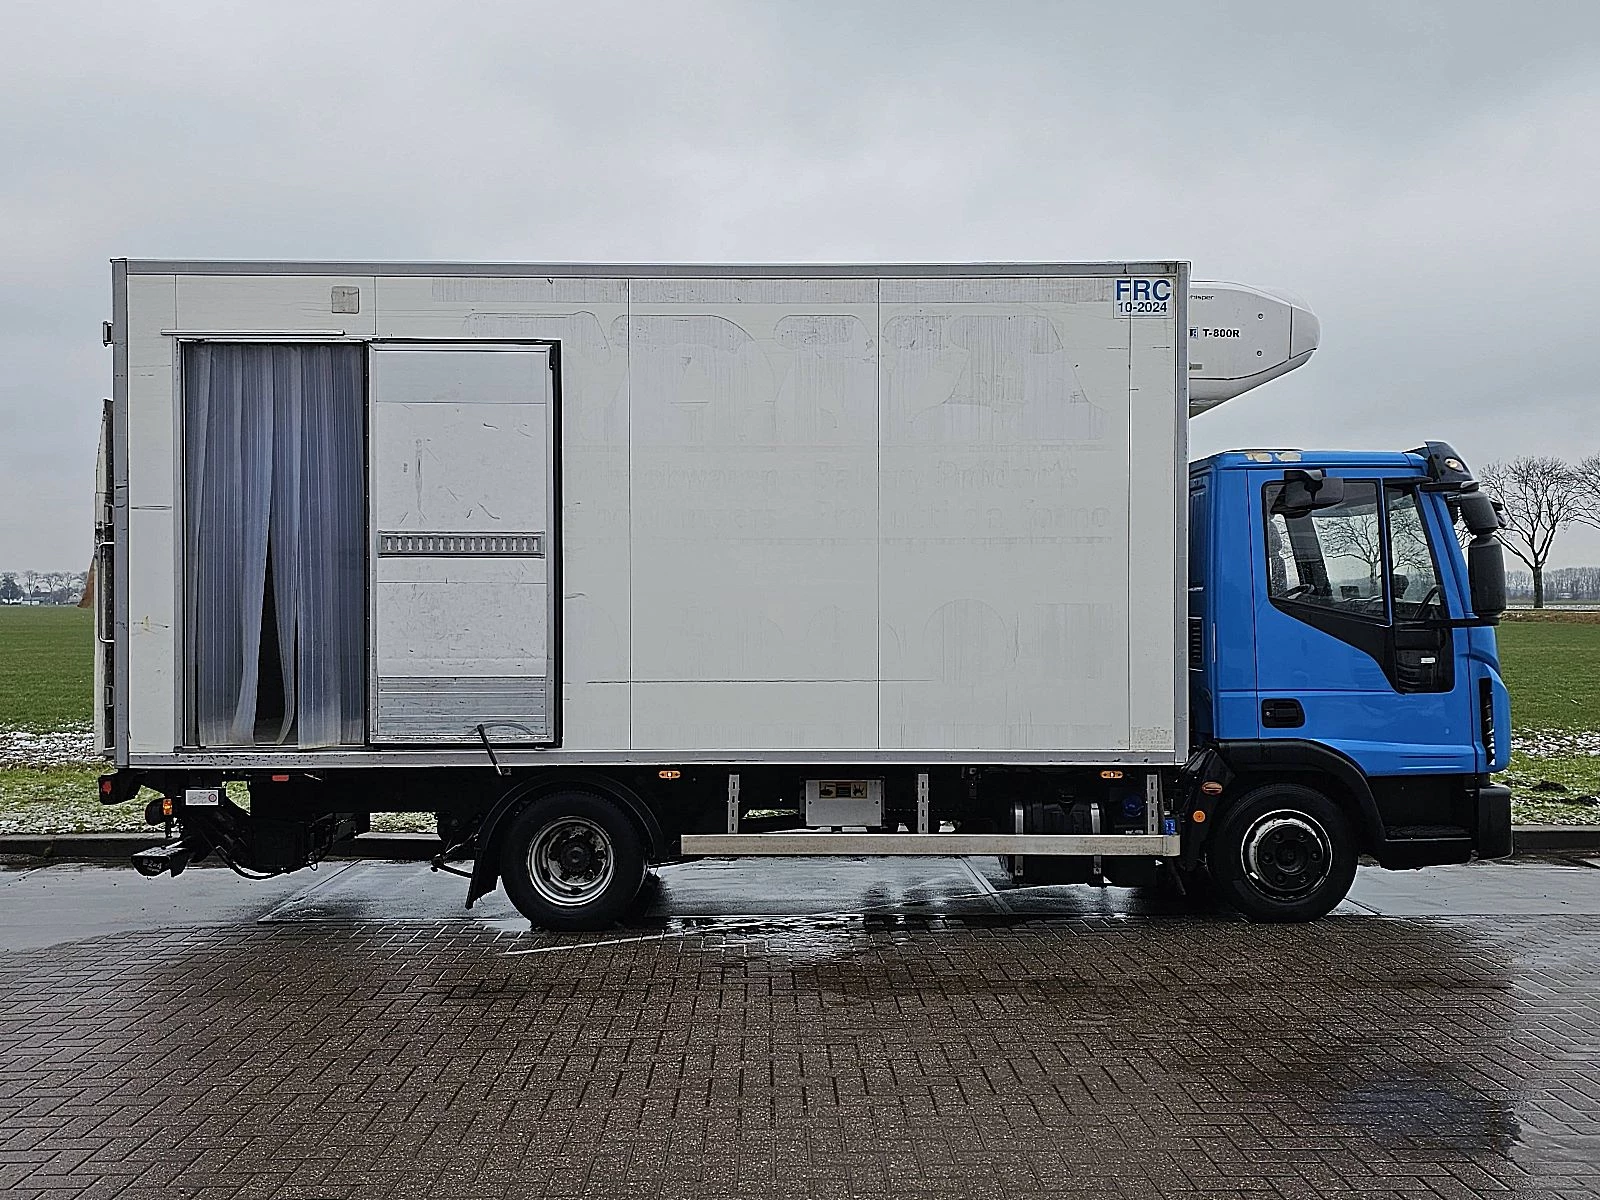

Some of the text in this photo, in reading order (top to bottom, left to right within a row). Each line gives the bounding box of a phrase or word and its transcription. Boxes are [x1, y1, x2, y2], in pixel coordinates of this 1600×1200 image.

[1116, 279, 1171, 301] FRC
[1118, 301, 1168, 313] 10-2024
[1202, 328, 1240, 338] T-800R
